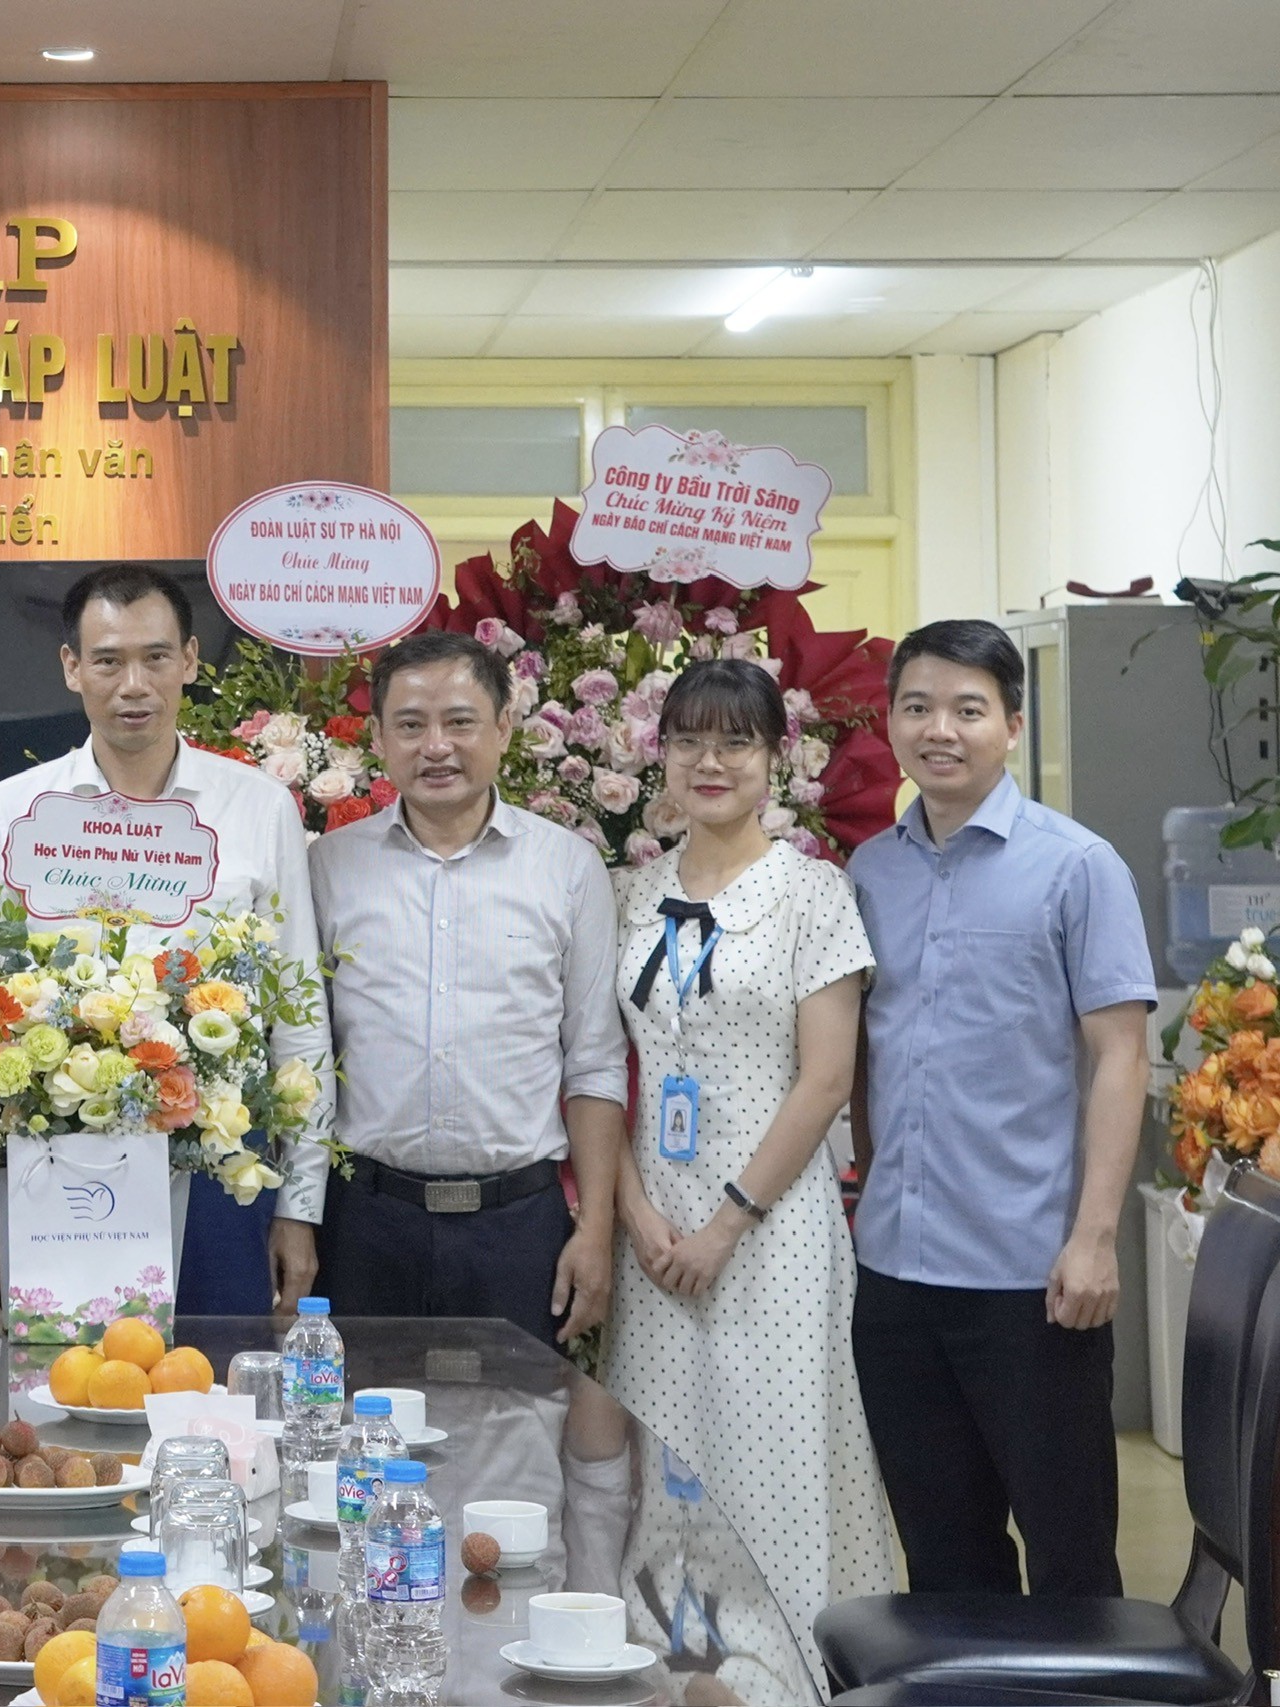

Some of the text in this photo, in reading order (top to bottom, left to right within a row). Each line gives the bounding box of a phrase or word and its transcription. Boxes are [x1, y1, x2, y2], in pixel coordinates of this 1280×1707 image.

[96, 317, 239, 418] LUẬT
[78, 439, 153, 478] văn
[604, 465, 800, 515] Công ty Bầu Trời Sáng
[605, 490, 649, 511] Chúc
[654, 497, 706, 524] Mừng
[741, 509, 788, 533] Niệm
[251, 518, 401, 544] ĐOÀN LUẬT SƯ TP HÀ NỘI
[592, 511, 791, 553] NGÀY BÁO CHÍ CÁCH MẠNG VIỆT NAM
[282, 551, 370, 574] Chúc Mừng
[229, 579, 423, 608] NGÀY BÁO CHÍ CÁCH MẠNG VIỆT NAM
[83, 821, 163, 840] KHOA LUẬT
[34, 843, 57, 859] Học
[62, 844, 91, 861] Viện
[94, 845, 118, 863] Phụ
[144, 849, 170, 867] Việt
[174, 851, 202, 865] Nam
[44, 867, 187, 897] Chúc Mừng
[31, 1234, 48, 1243] HỌC
[51, 1232, 72, 1242] VIỆN
[107, 1231, 127, 1242] VIỆT
[129, 1231, 149, 1240] NAM
[311, 1371, 340, 1384] laVie
[340, 1484, 365, 1499] aVie
[152, 1663, 185, 1688] laVi
